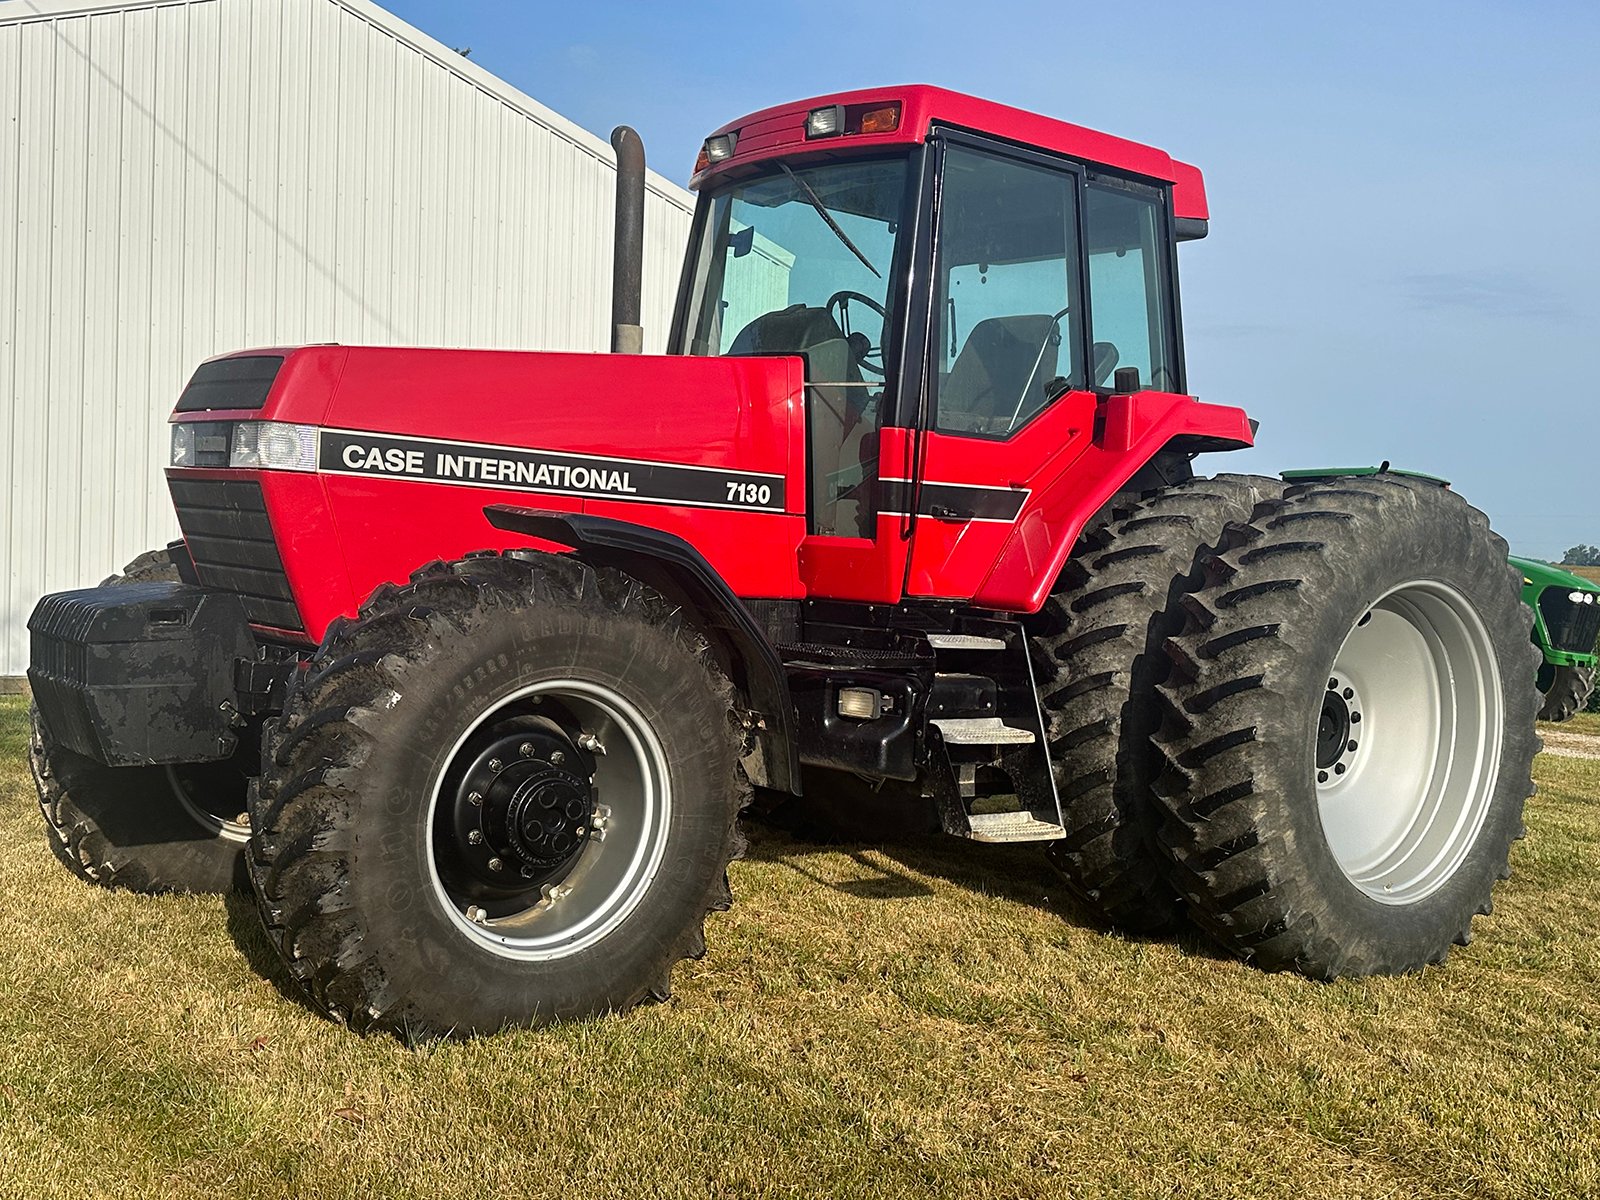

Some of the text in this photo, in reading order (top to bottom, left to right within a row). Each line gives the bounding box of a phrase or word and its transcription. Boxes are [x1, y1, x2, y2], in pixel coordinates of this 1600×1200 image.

[342, 444, 637, 493] CASE INTERNATIONAL
[726, 481, 771, 505] 7130
